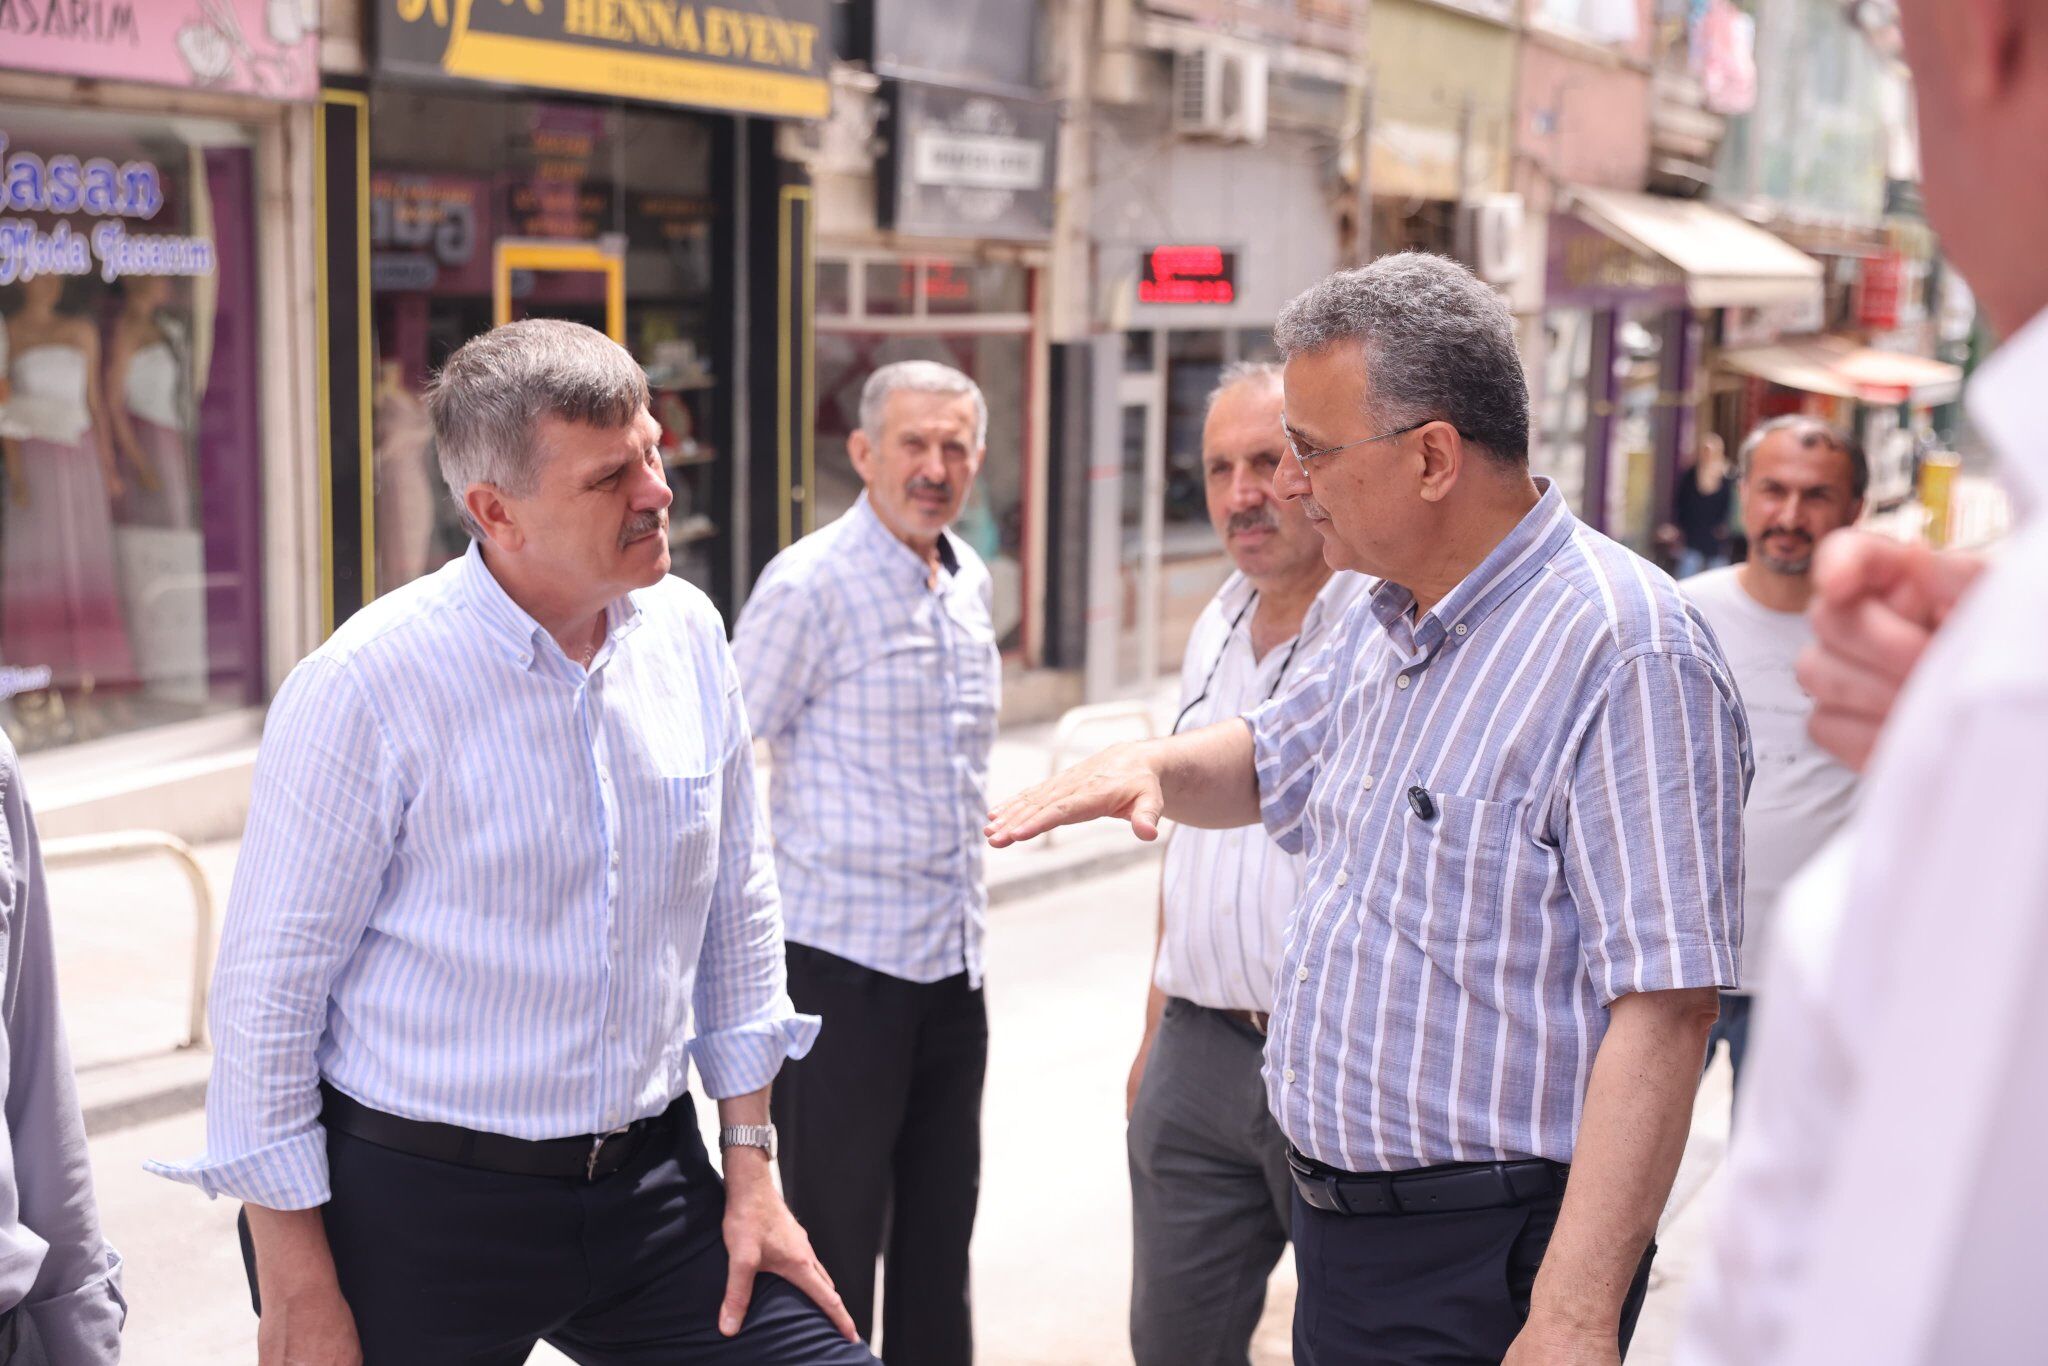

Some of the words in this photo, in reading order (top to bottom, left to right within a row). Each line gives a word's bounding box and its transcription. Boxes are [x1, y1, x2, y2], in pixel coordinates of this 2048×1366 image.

[563, 0, 702, 53] HENNA
[704, 6, 819, 71] EVENT
[0, 153, 160, 216] asan
